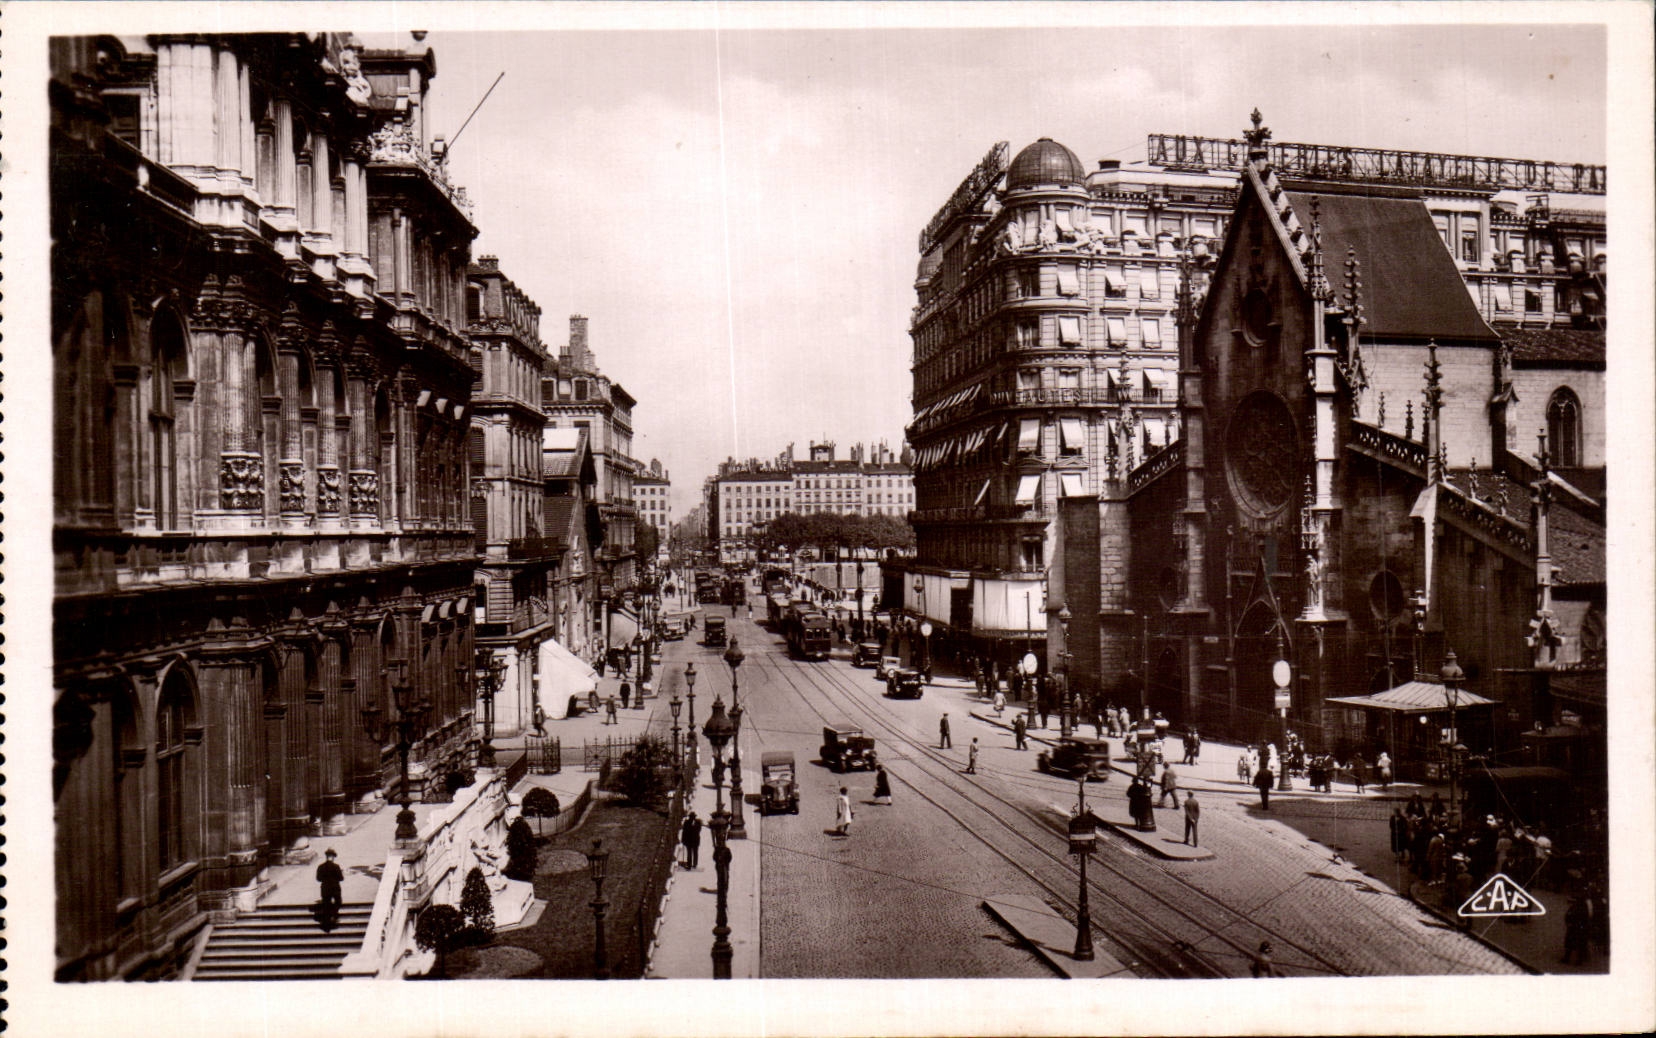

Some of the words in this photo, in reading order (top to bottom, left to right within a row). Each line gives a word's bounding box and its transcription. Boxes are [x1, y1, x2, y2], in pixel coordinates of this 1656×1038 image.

[1157, 134, 1204, 164] AUX
[1227, 139, 1352, 174] GERIES
[1525, 160, 1555, 186] DE
